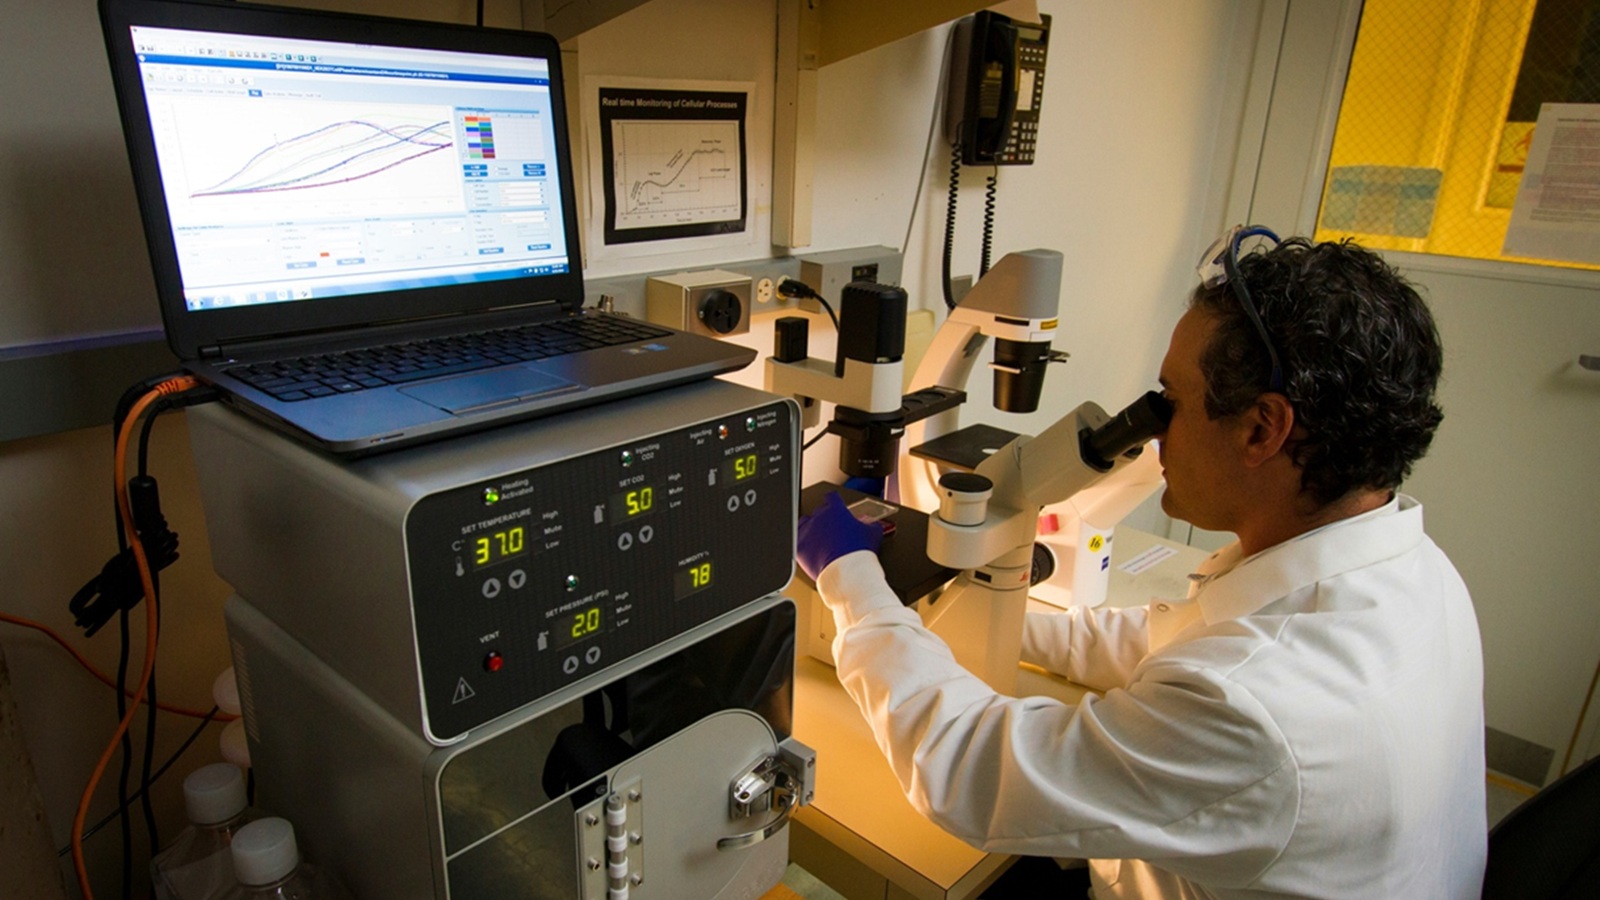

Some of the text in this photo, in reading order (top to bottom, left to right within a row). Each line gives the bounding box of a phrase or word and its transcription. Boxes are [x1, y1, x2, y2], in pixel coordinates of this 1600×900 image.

[602, 97, 738, 109] Real time Monitoring of Cellular Processes
[757, 411, 777, 421] Injecting
[757, 419, 777, 428] Nitrogen
[690, 428, 713, 439] Injecting
[696, 438, 705, 446] Air
[769, 443, 780, 451] High
[635, 443, 660, 455] Injecting
[724, 442, 755, 456] SET OXYGEN
[641, 451, 655, 461] CO2
[735, 454, 757, 480] 5.0
[769, 467, 780, 475] Low
[619, 474, 645, 488] SET CO2
[668, 472, 682, 481] High
[501, 478, 529, 490] Heating
[501, 486, 534, 500] Activated
[668, 486, 684, 496] Mute
[626, 486, 652, 516] 5.0
[669, 500, 682, 509] Low
[542, 509, 559, 520] High
[461, 507, 532, 535] SET TEMPERATURE
[543, 523, 563, 535] Mute
[545, 539, 560, 549] Low
[1090, 537, 1101, 549] 16
[690, 562, 711, 588] 78
[615, 591, 629, 601] High
[545, 588, 609, 619] SET PRESSURE (PSI)
[615, 604, 632, 614] Mute
[571, 607, 600, 638] 2.0
[616, 618, 630, 627] Low
[479, 630, 500, 643] VENT
